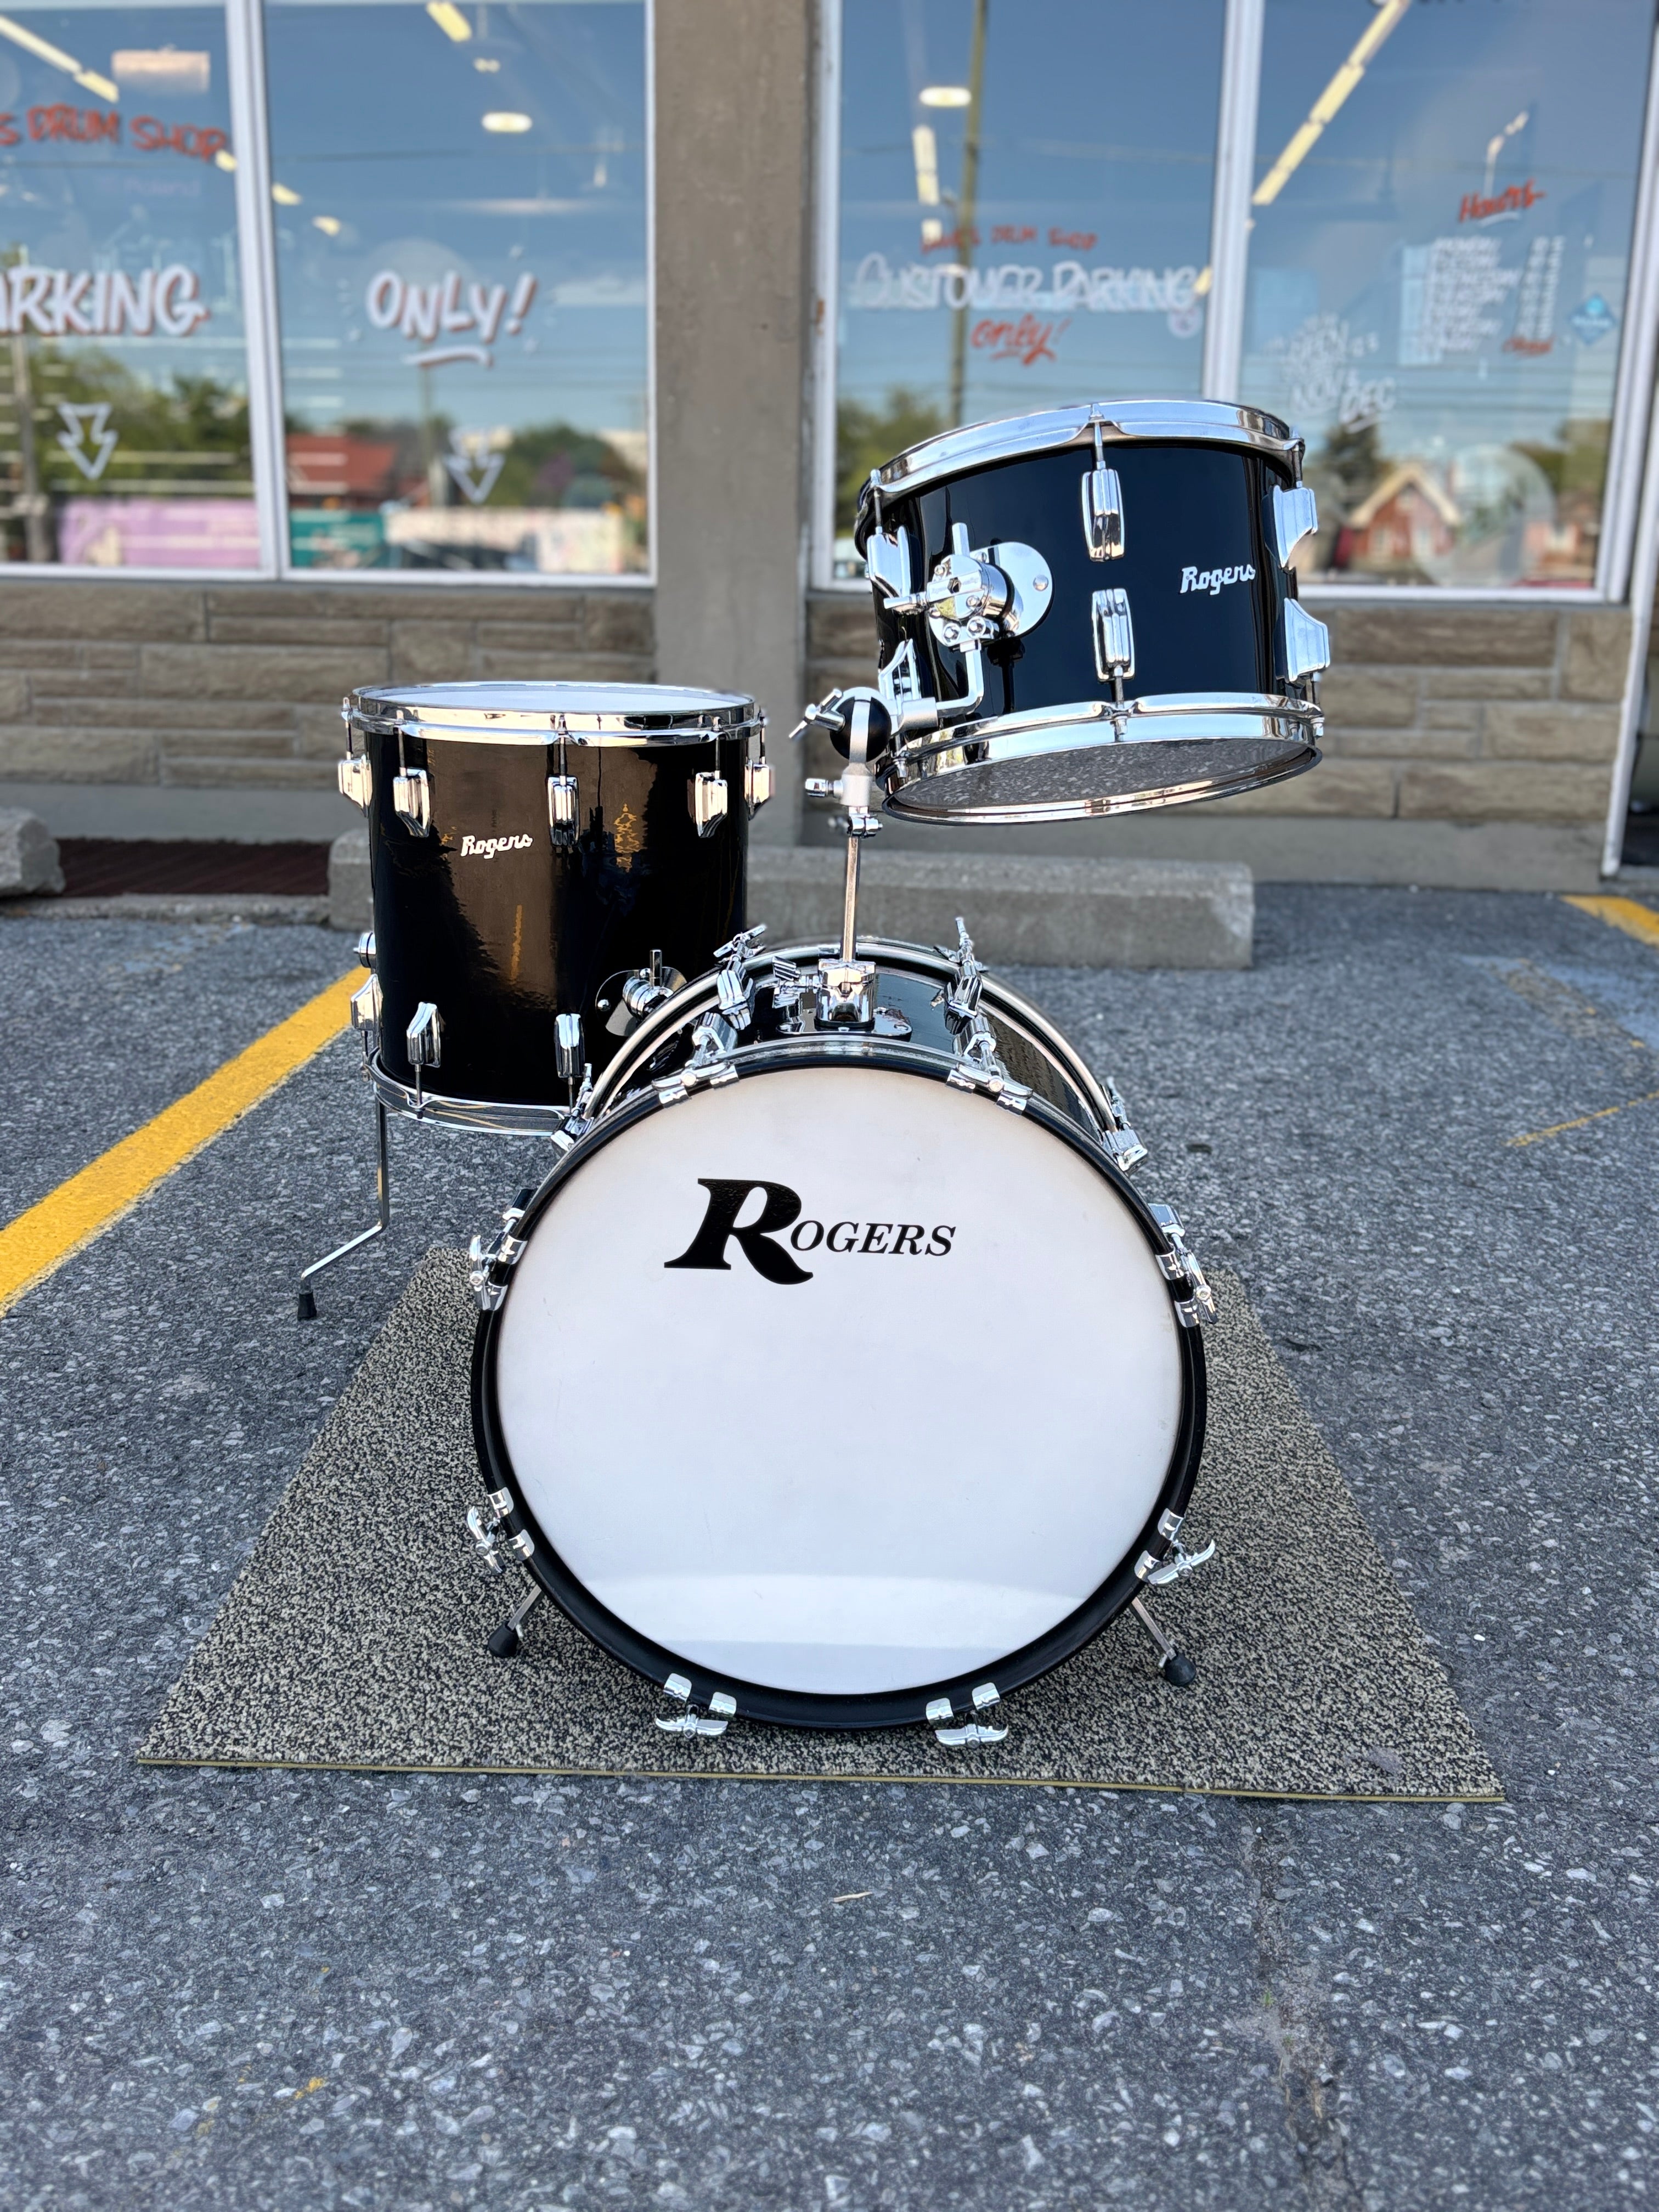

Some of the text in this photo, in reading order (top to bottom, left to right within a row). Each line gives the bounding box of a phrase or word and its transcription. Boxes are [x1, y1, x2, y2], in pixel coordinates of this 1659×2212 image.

[26, 102, 120, 144] DRUM
[128, 115, 227, 163] SHOP
[0, 264, 538, 343] RKING ONLY!
[1180, 563, 1256, 596] Rogers
[460, 833, 534, 860] Rogers
